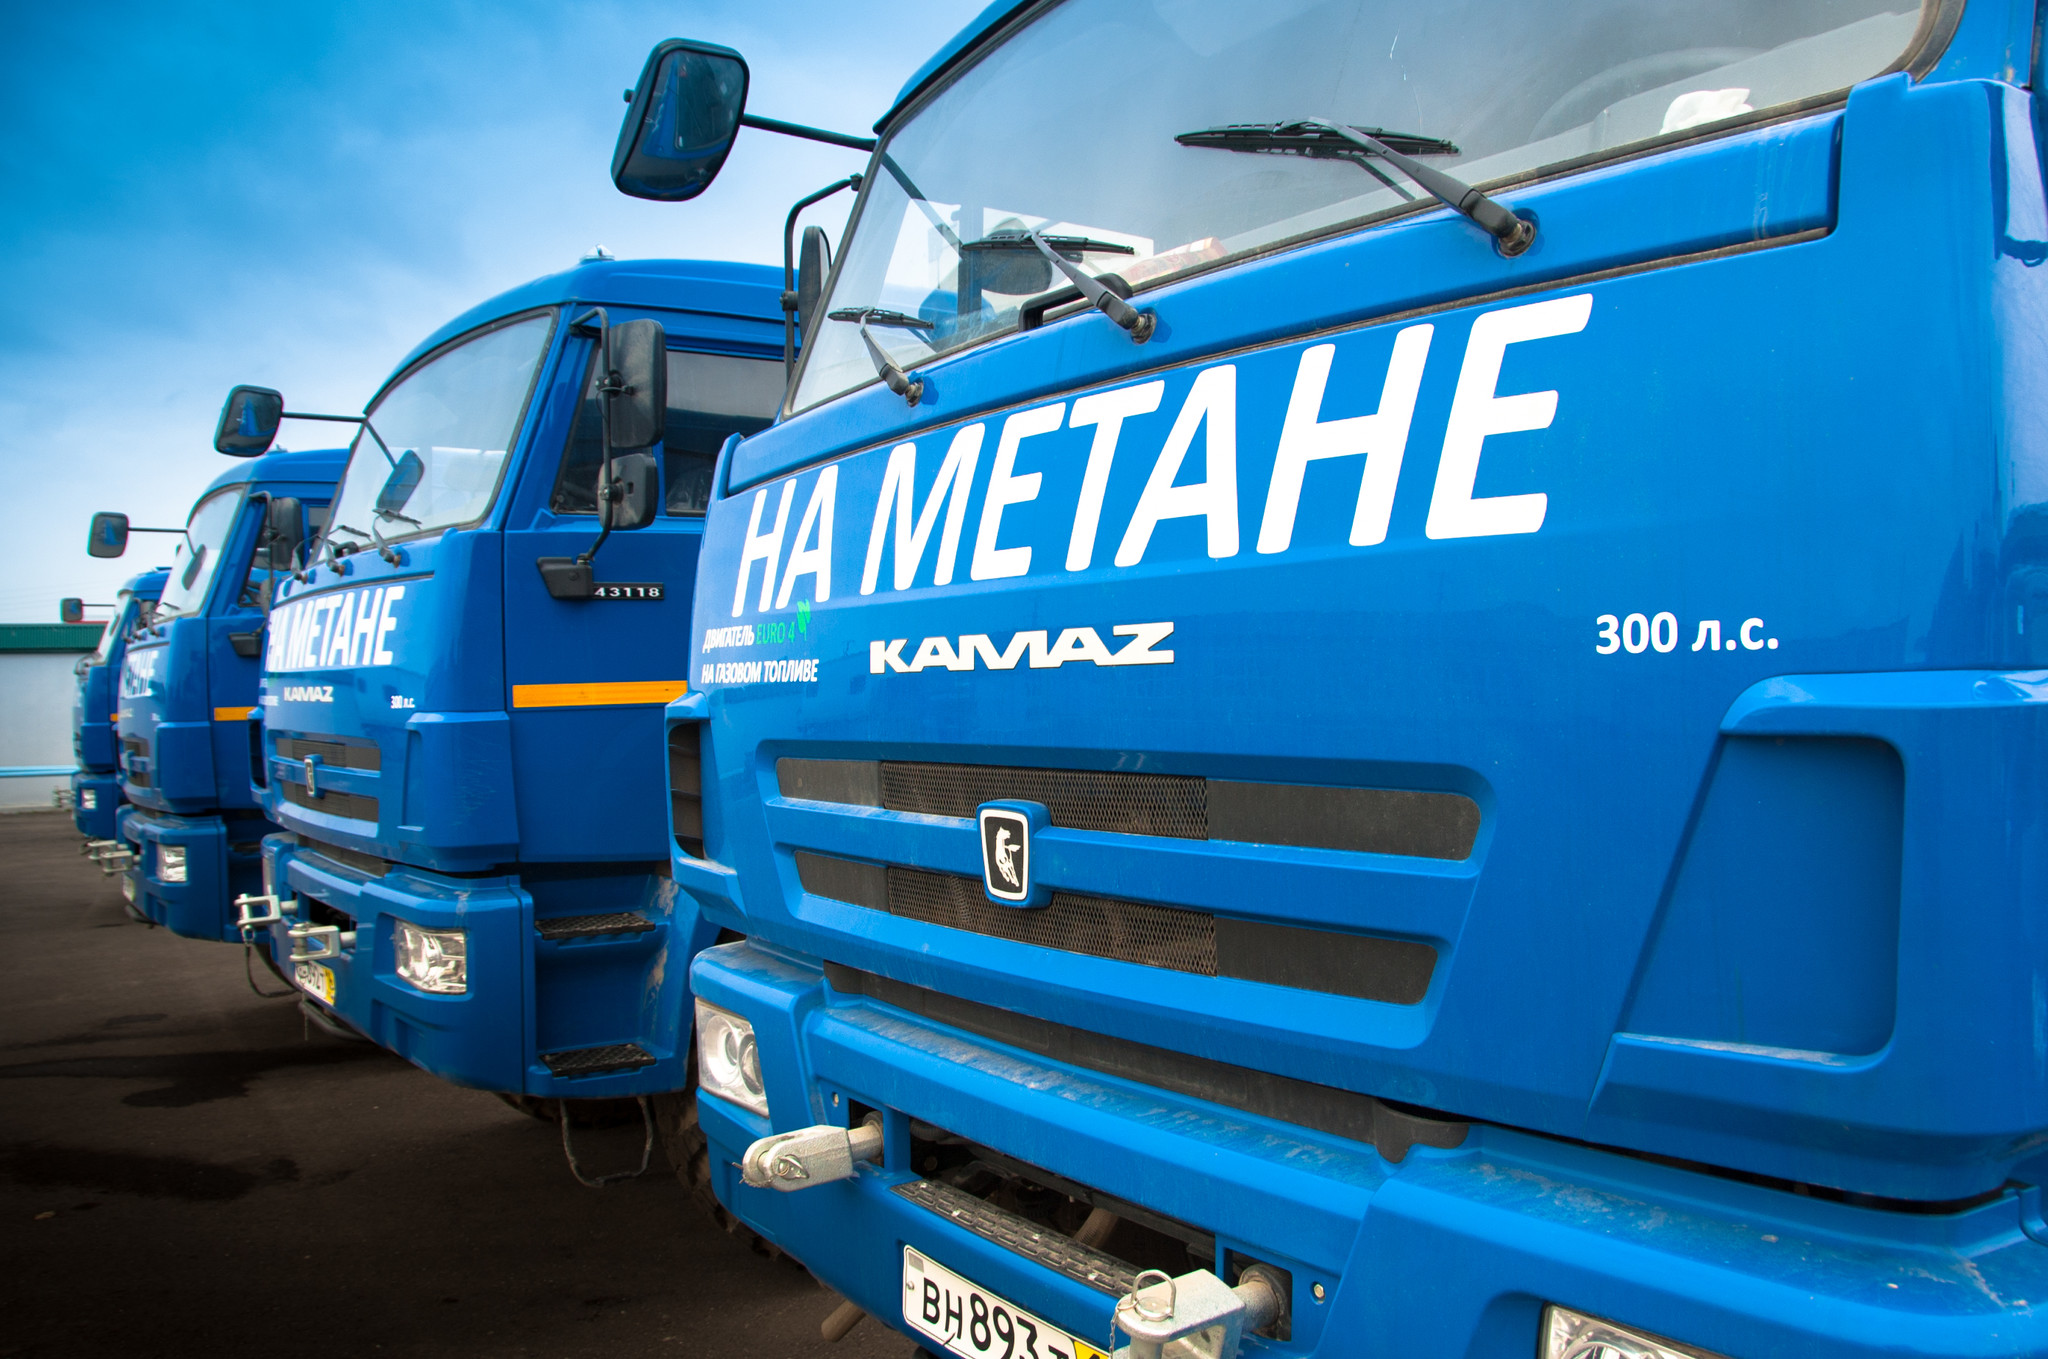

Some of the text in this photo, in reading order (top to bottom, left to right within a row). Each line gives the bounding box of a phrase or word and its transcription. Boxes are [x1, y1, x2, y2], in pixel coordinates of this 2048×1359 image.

[732, 293, 1594, 617] НА МЕТАНЕ
[594, 587, 660, 597] 43118
[285, 586, 405, 666] МЕТАНЕ
[702, 621, 796, 654] ДВИГАТЕЛЬ EURO 4
[1596, 611, 1779, 655] 300 л.с.
[870, 621, 1175, 675] KAMAZ
[701, 658, 820, 684] НА ГАЗОВОМ ТОПЛИВЕ
[283, 686, 334, 703] KAMAZ
